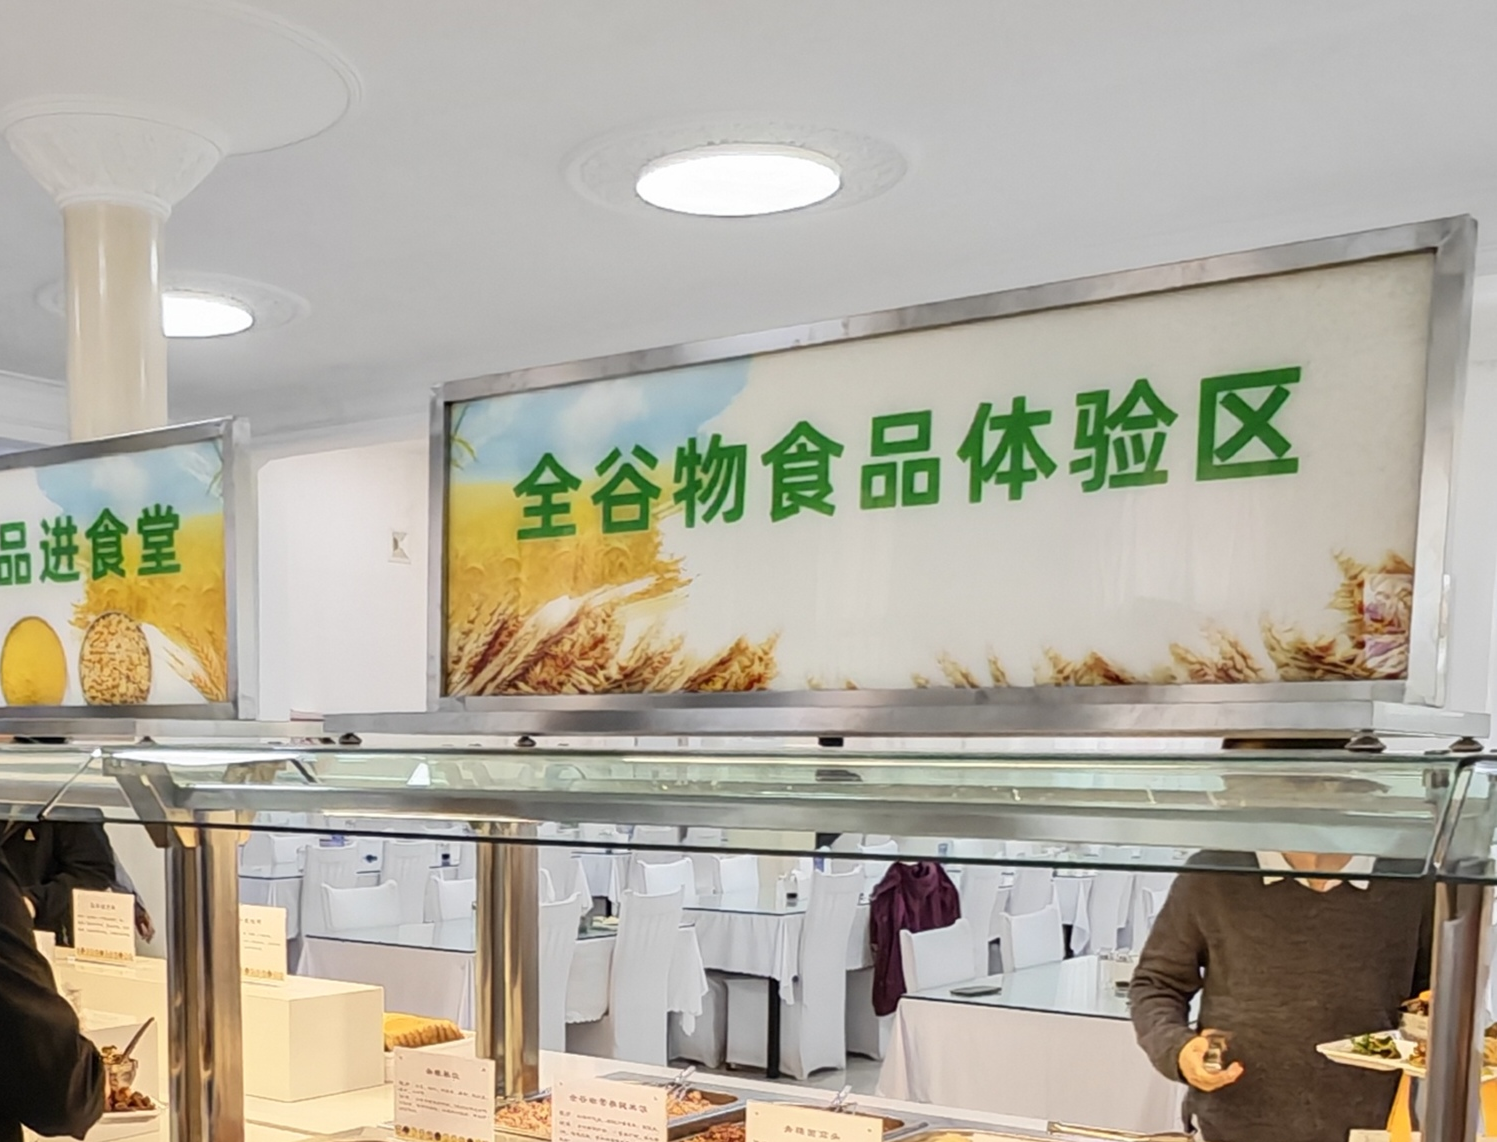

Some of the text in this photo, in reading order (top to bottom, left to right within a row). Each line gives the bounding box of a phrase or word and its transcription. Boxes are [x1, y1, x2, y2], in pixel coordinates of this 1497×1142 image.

[512, 365, 1304, 542] 全谷物食品体验区
